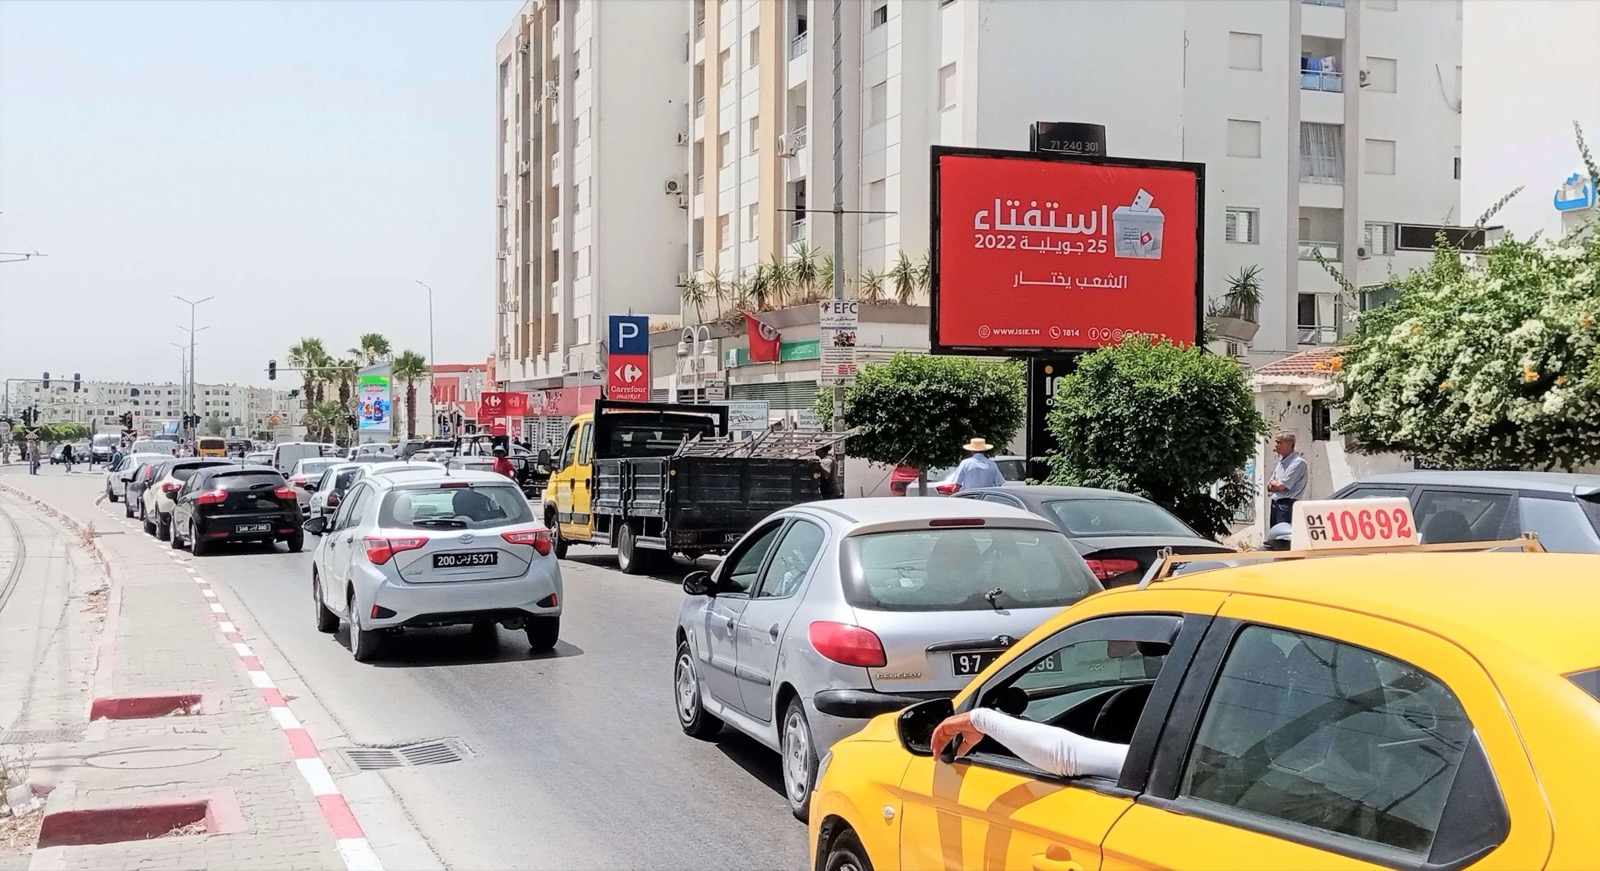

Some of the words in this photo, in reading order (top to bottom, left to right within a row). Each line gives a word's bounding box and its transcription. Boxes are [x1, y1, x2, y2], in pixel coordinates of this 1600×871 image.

[1050, 141, 1060, 150] 71
[1063, 141, 1083, 151] 240
[1084, 142, 1099, 152] 301
[974, 198, 1108, 236] استفتاء
[974, 234, 1016, 249] 2022
[1020, 235, 1085, 255] جويلية
[1087, 239, 1108, 254] 25
[1013, 270, 1072, 290] يختار
[1075, 273, 1128, 290] الشعب
[834, 302, 858, 314] EFC
[618, 322, 639, 349] P
[993, 328, 1040, 336] WWW.ISIE.TN
[1062, 329, 1080, 337] 1814
[610, 385, 647, 394] Carrefour
[1307, 514, 1324, 526] 01
[1327, 508, 1412, 541] 10692
[1310, 529, 1327, 541] 01
[437, 556, 455, 566] 200
[473, 553, 494, 564] 5371
[1030, 655, 1055, 672] 96
[876, 671, 923, 680] PEUGEOT
